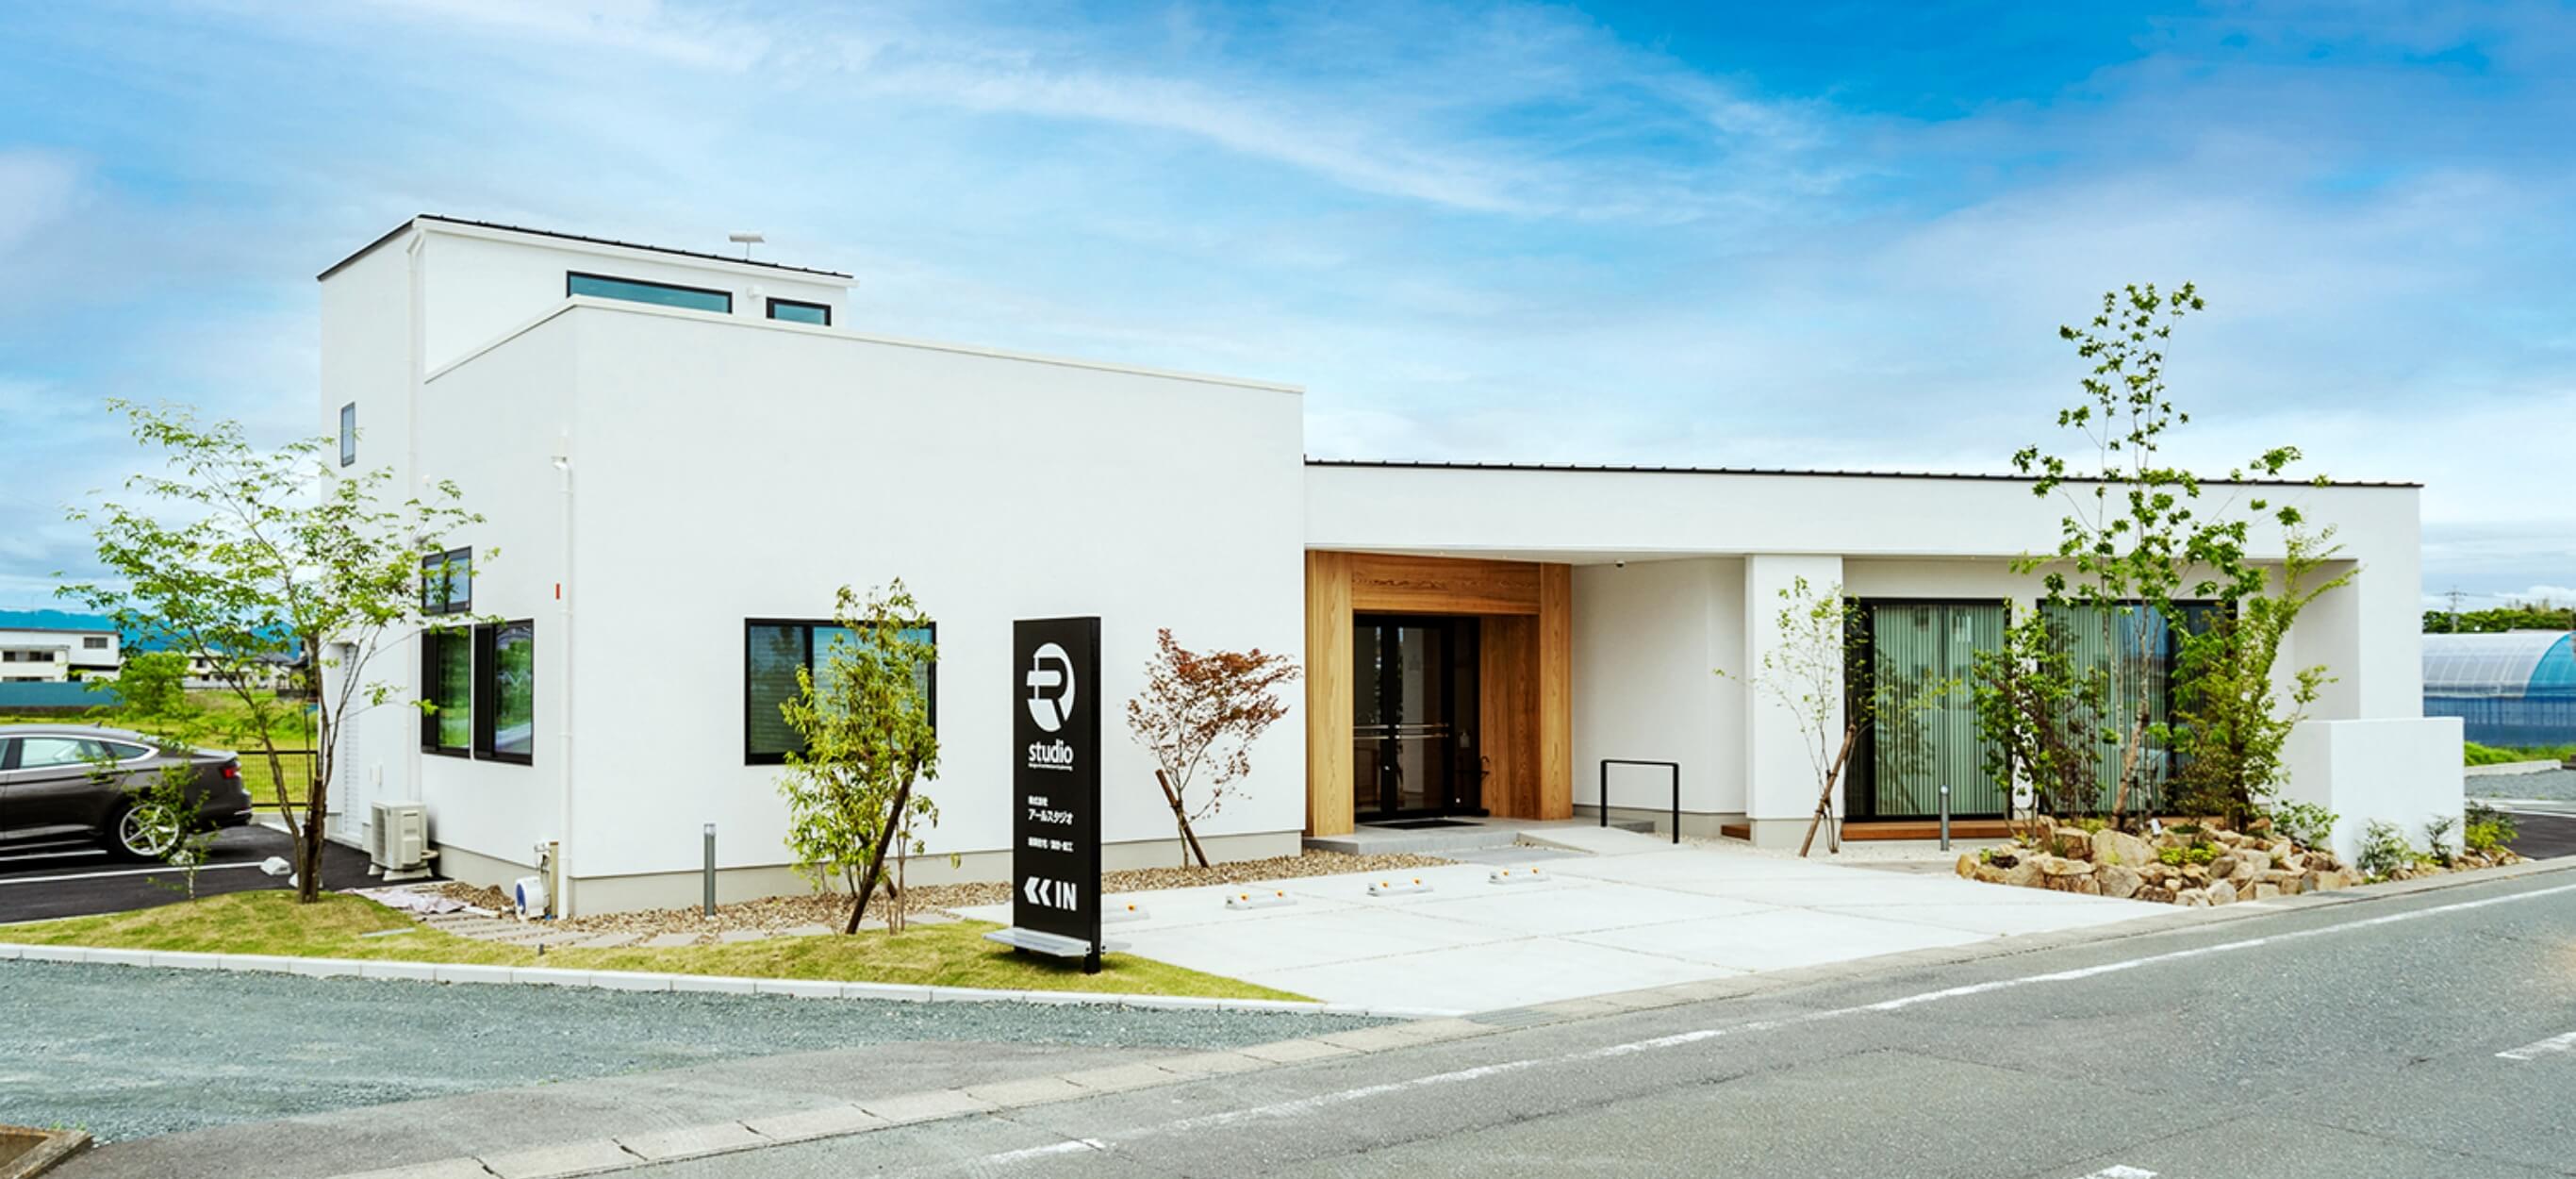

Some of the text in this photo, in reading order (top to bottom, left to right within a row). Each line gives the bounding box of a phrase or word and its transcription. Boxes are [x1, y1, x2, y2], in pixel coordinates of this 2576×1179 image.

[1028, 739, 1074, 764] studio
[1028, 808, 1074, 825] アールスタジオ
[1055, 880, 1077, 911] IN
